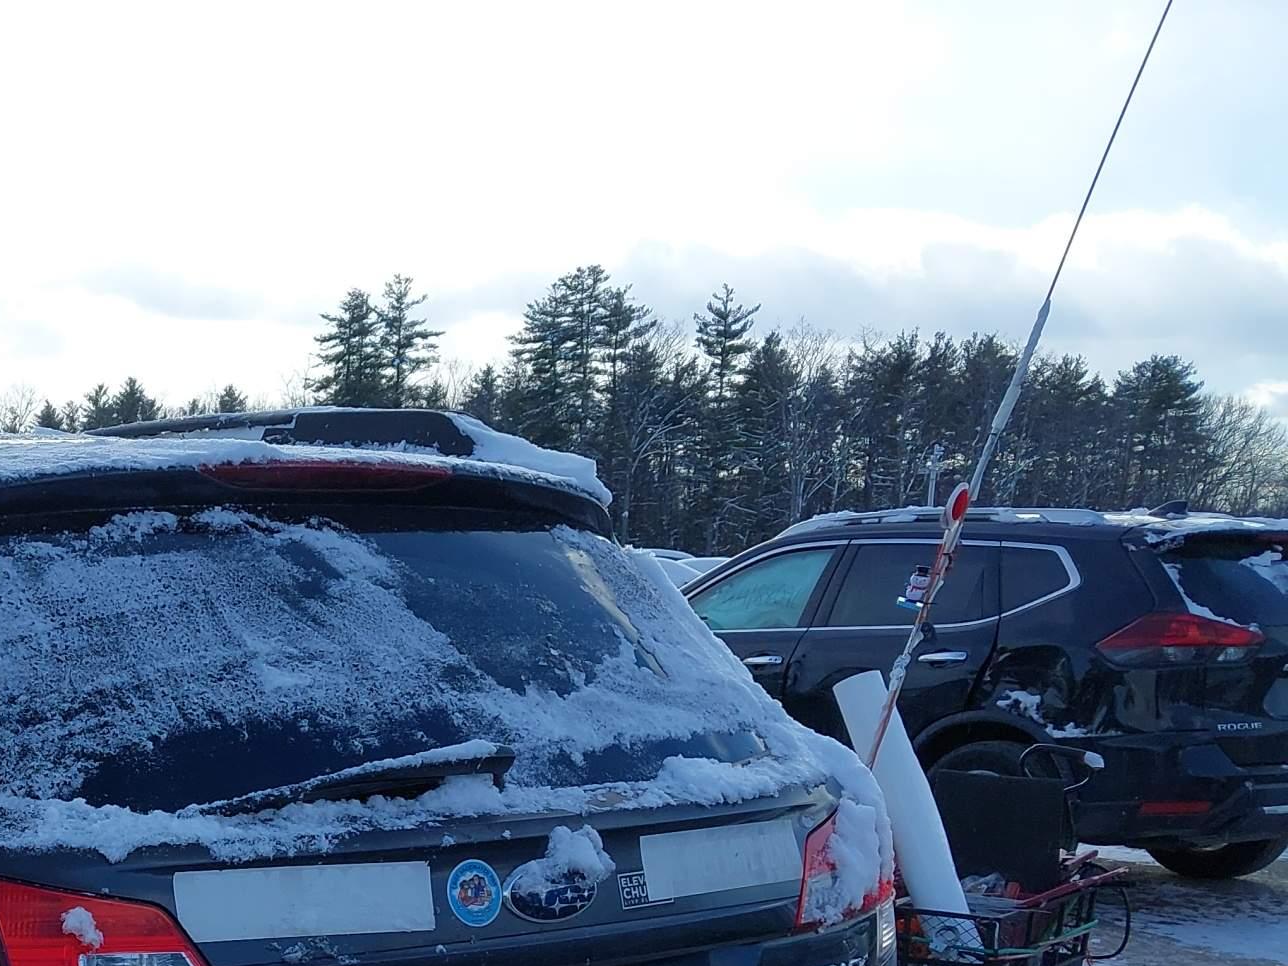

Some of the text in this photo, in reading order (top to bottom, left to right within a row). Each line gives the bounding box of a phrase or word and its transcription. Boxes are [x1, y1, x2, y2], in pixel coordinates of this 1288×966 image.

[1217, 722, 1263, 731] ROGUE
[621, 875, 645, 888] ELEV
[623, 885, 647, 899] CHU
